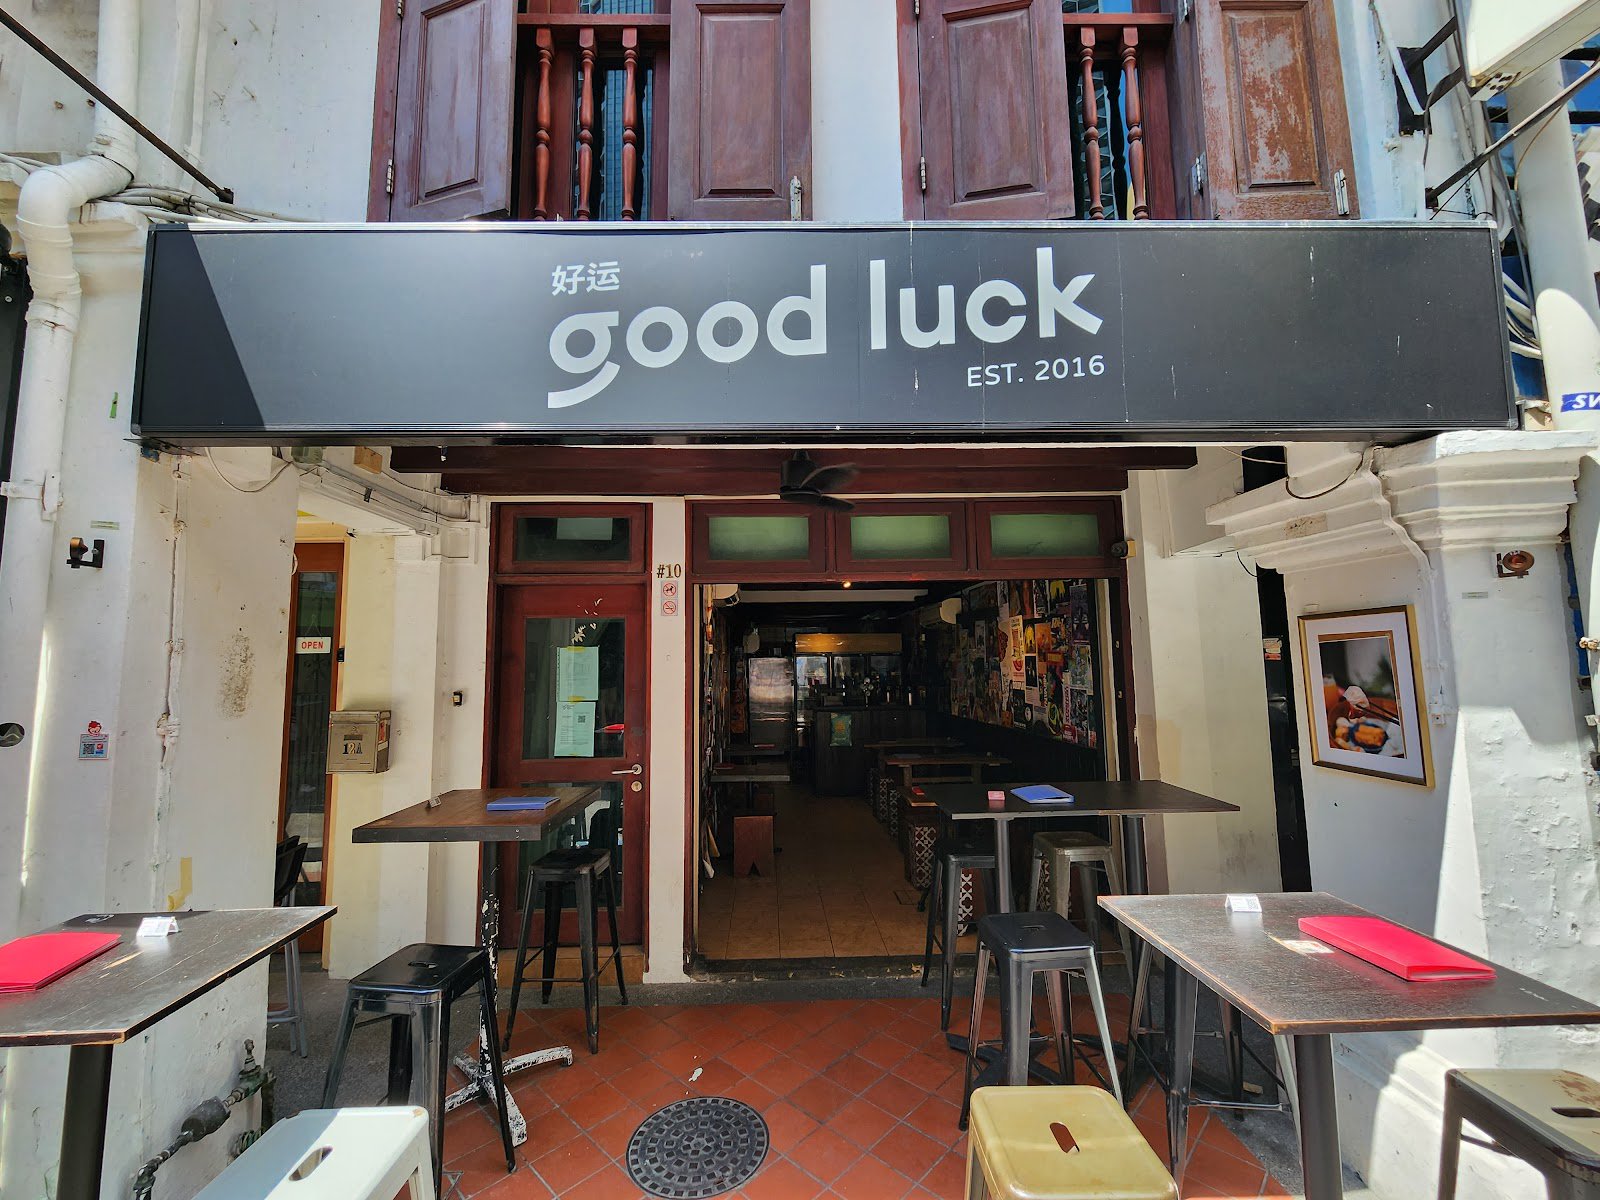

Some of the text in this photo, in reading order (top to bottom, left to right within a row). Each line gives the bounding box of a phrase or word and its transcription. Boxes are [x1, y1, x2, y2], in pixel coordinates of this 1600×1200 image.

[551, 261, 621, 297] 好运
[548, 246, 1103, 409] good luck
[967, 355, 1105, 387] EST. 2016
[656, 563, 682, 579] #10
[301, 641, 324, 650] OPEN
